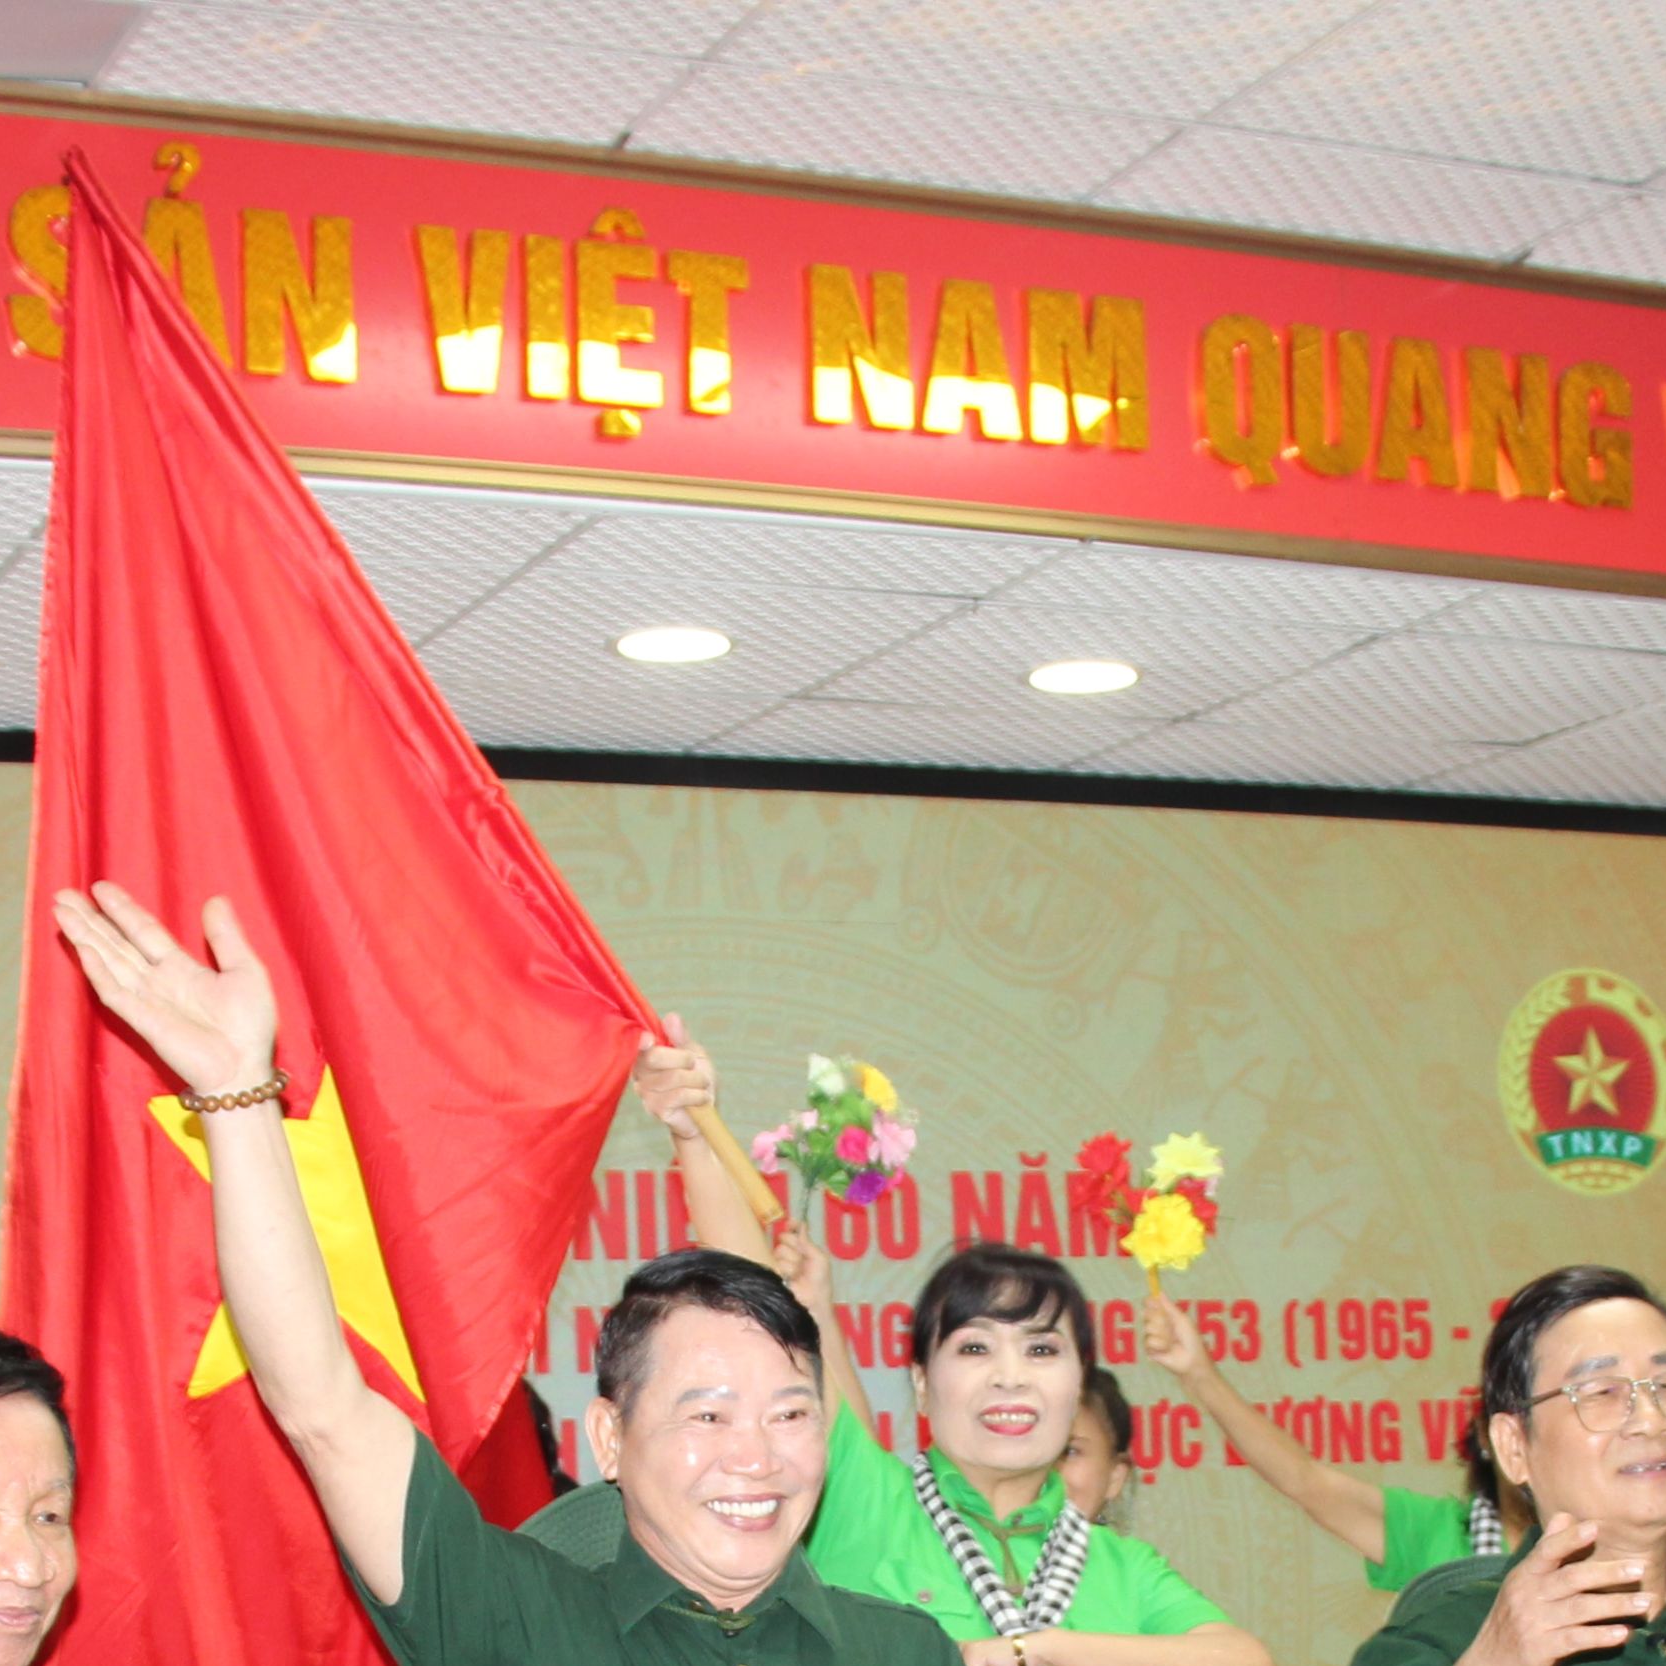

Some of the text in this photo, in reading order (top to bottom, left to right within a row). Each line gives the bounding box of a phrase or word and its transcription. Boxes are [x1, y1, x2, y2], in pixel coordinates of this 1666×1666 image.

[414, 207, 749, 438] VIỆT
[807, 261, 1149, 451] NAM
[1195, 312, 1635, 511] QUANG
[1546, 1130, 1643, 1158] TNXP
[824, 1170, 921, 1261] 60
[1176, 1299, 1262, 1363] 53
[1283, 1298, 1433, 1369] (1965
[1451, 1327, 1471, 1340] -
[1129, 1397, 1203, 1485] ỰC
